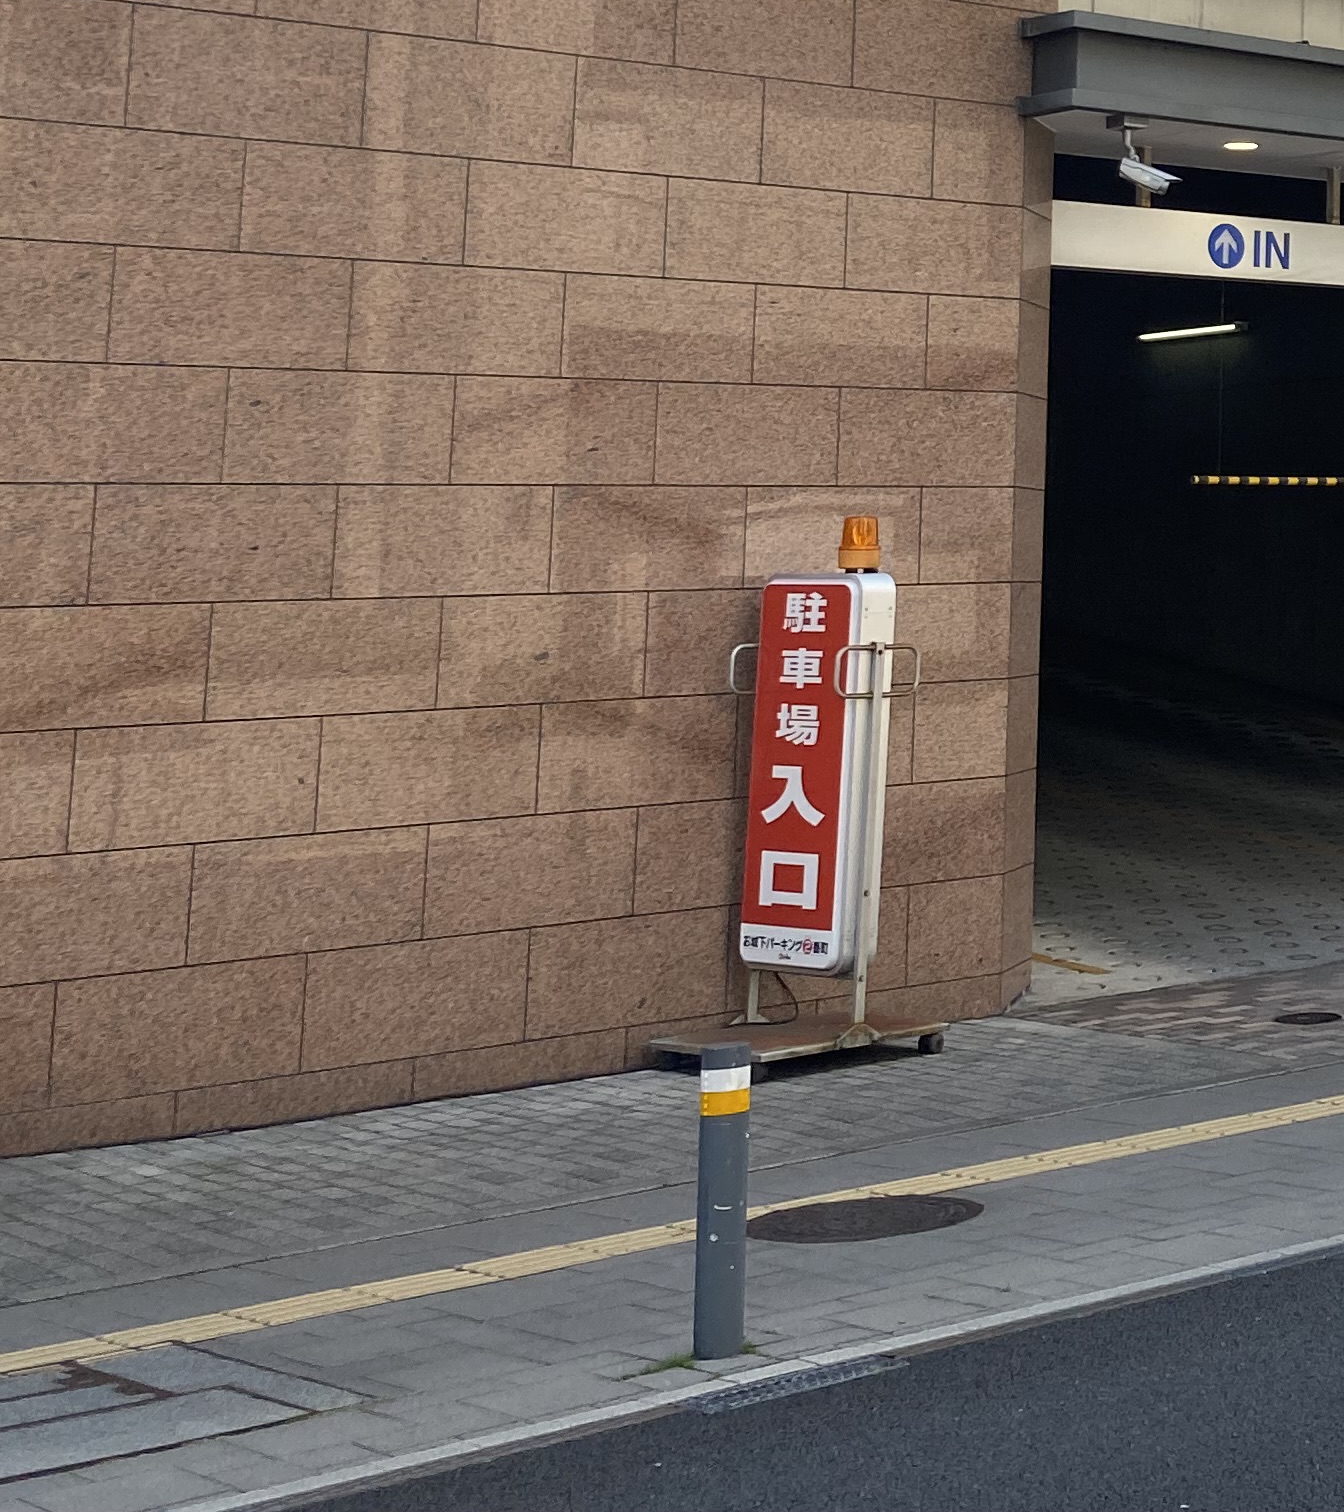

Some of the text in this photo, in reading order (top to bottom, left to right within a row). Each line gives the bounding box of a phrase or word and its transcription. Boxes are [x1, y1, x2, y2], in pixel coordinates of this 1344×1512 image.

[1253, 231, 1291, 270] IN
[758, 592, 828, 911] 駐車場入口
